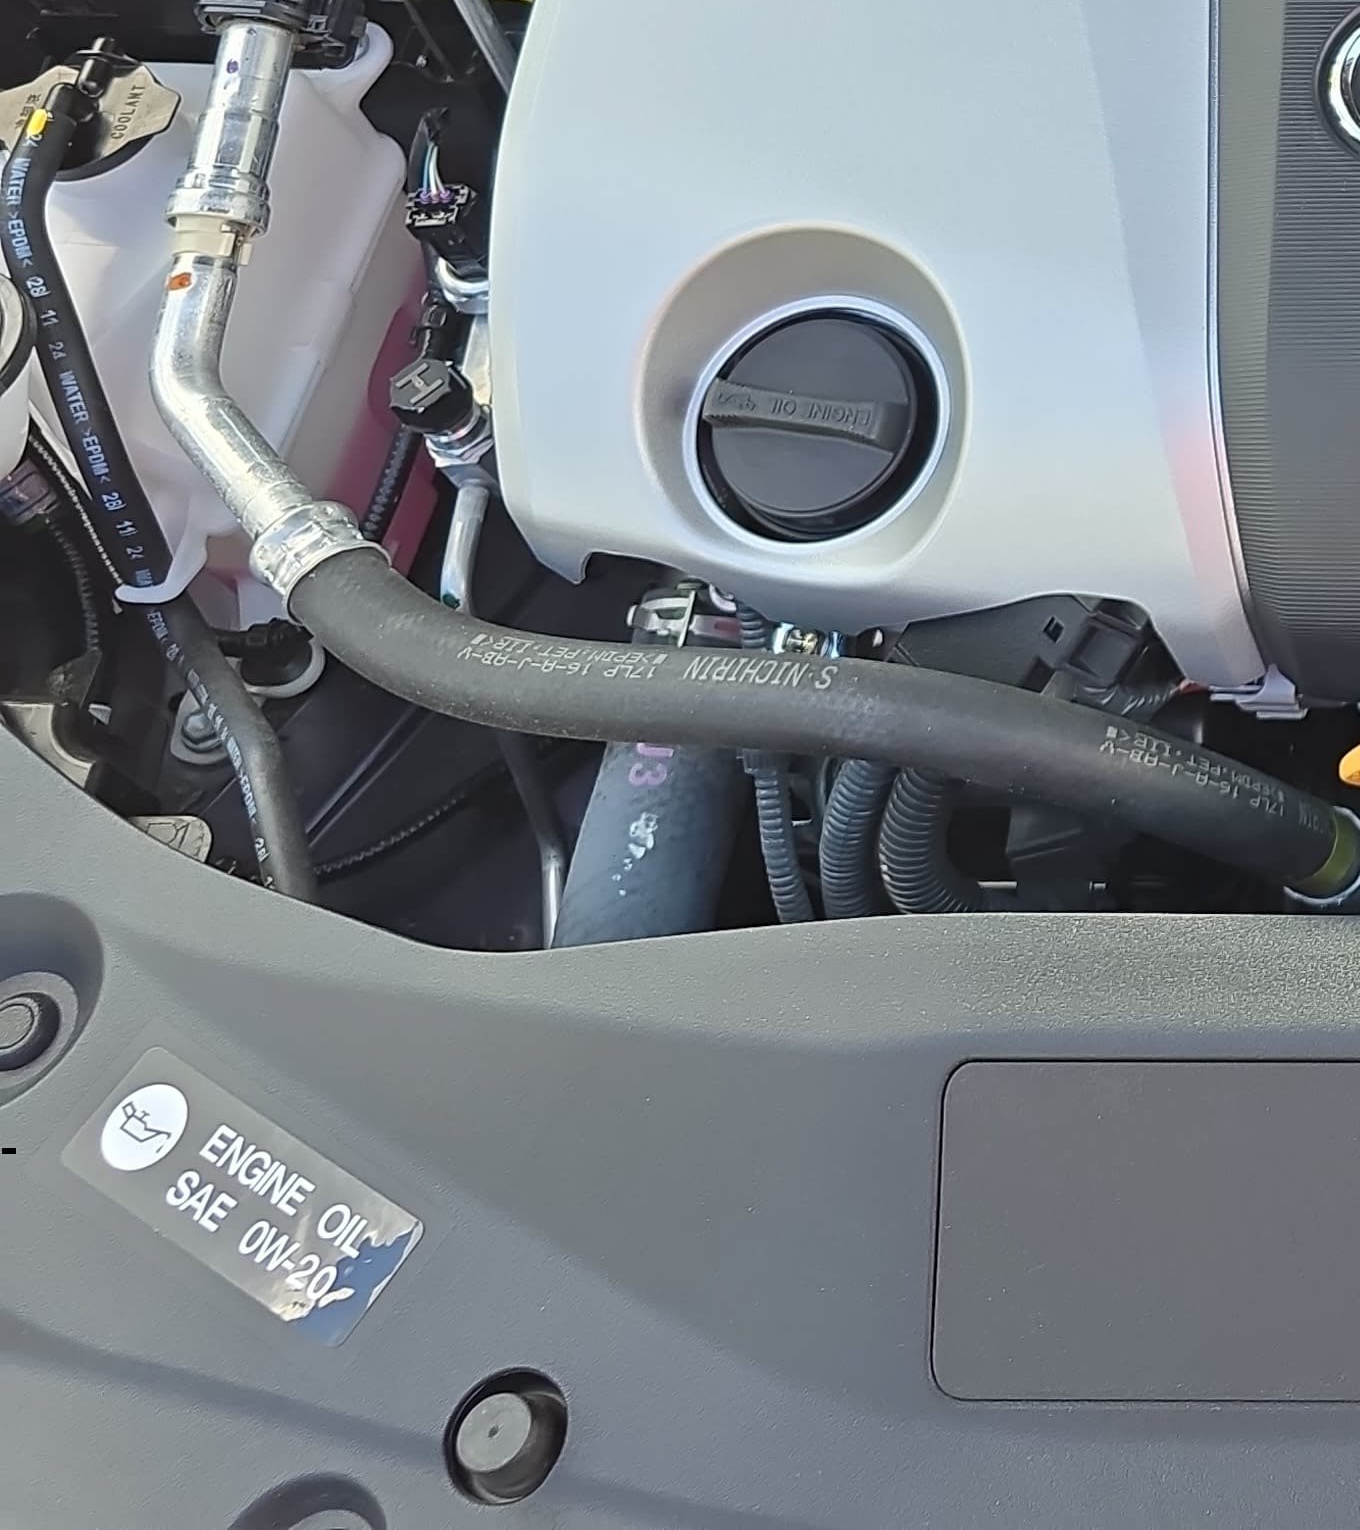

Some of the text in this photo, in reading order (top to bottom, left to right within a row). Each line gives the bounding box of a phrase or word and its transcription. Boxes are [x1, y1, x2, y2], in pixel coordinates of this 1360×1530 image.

[109, 82, 145, 141] COOLANT
[6, 156, 30, 206] WATER
[48, 341, 67, 360] 24
[58, 370, 89, 424] WATER
[79, 427, 111, 483] >EPDM<
[603, 665, 656, 678] 17LP
[165, 1167, 340, 1309] SAE 0W-20
[199, 1122, 369, 1259] ENGINE OIL
